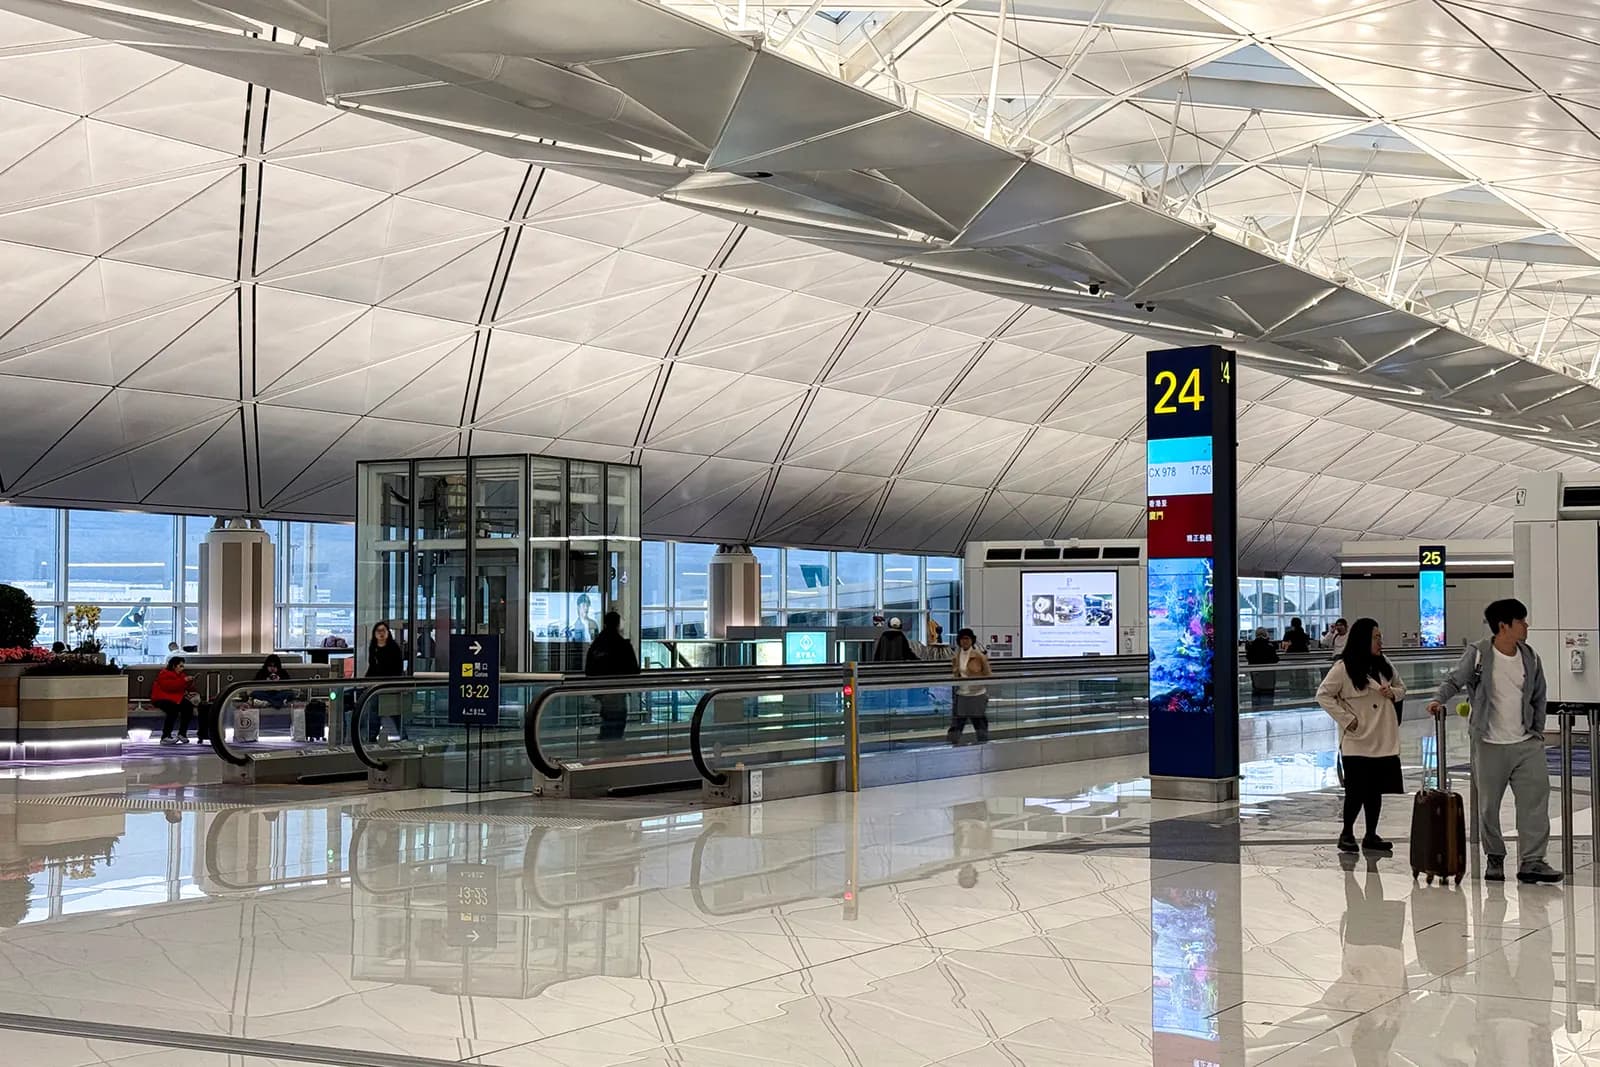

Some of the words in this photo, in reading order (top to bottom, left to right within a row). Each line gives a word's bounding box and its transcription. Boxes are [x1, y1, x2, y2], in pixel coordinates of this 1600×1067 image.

[1154, 368, 1205, 414] 24
[1149, 468, 1160, 478] CX
[1162, 467, 1176, 477] 978
[1191, 465, 1211, 476] 17:50
[1422, 551, 1441, 566] 25
[460, 684, 490, 698] 13-22
